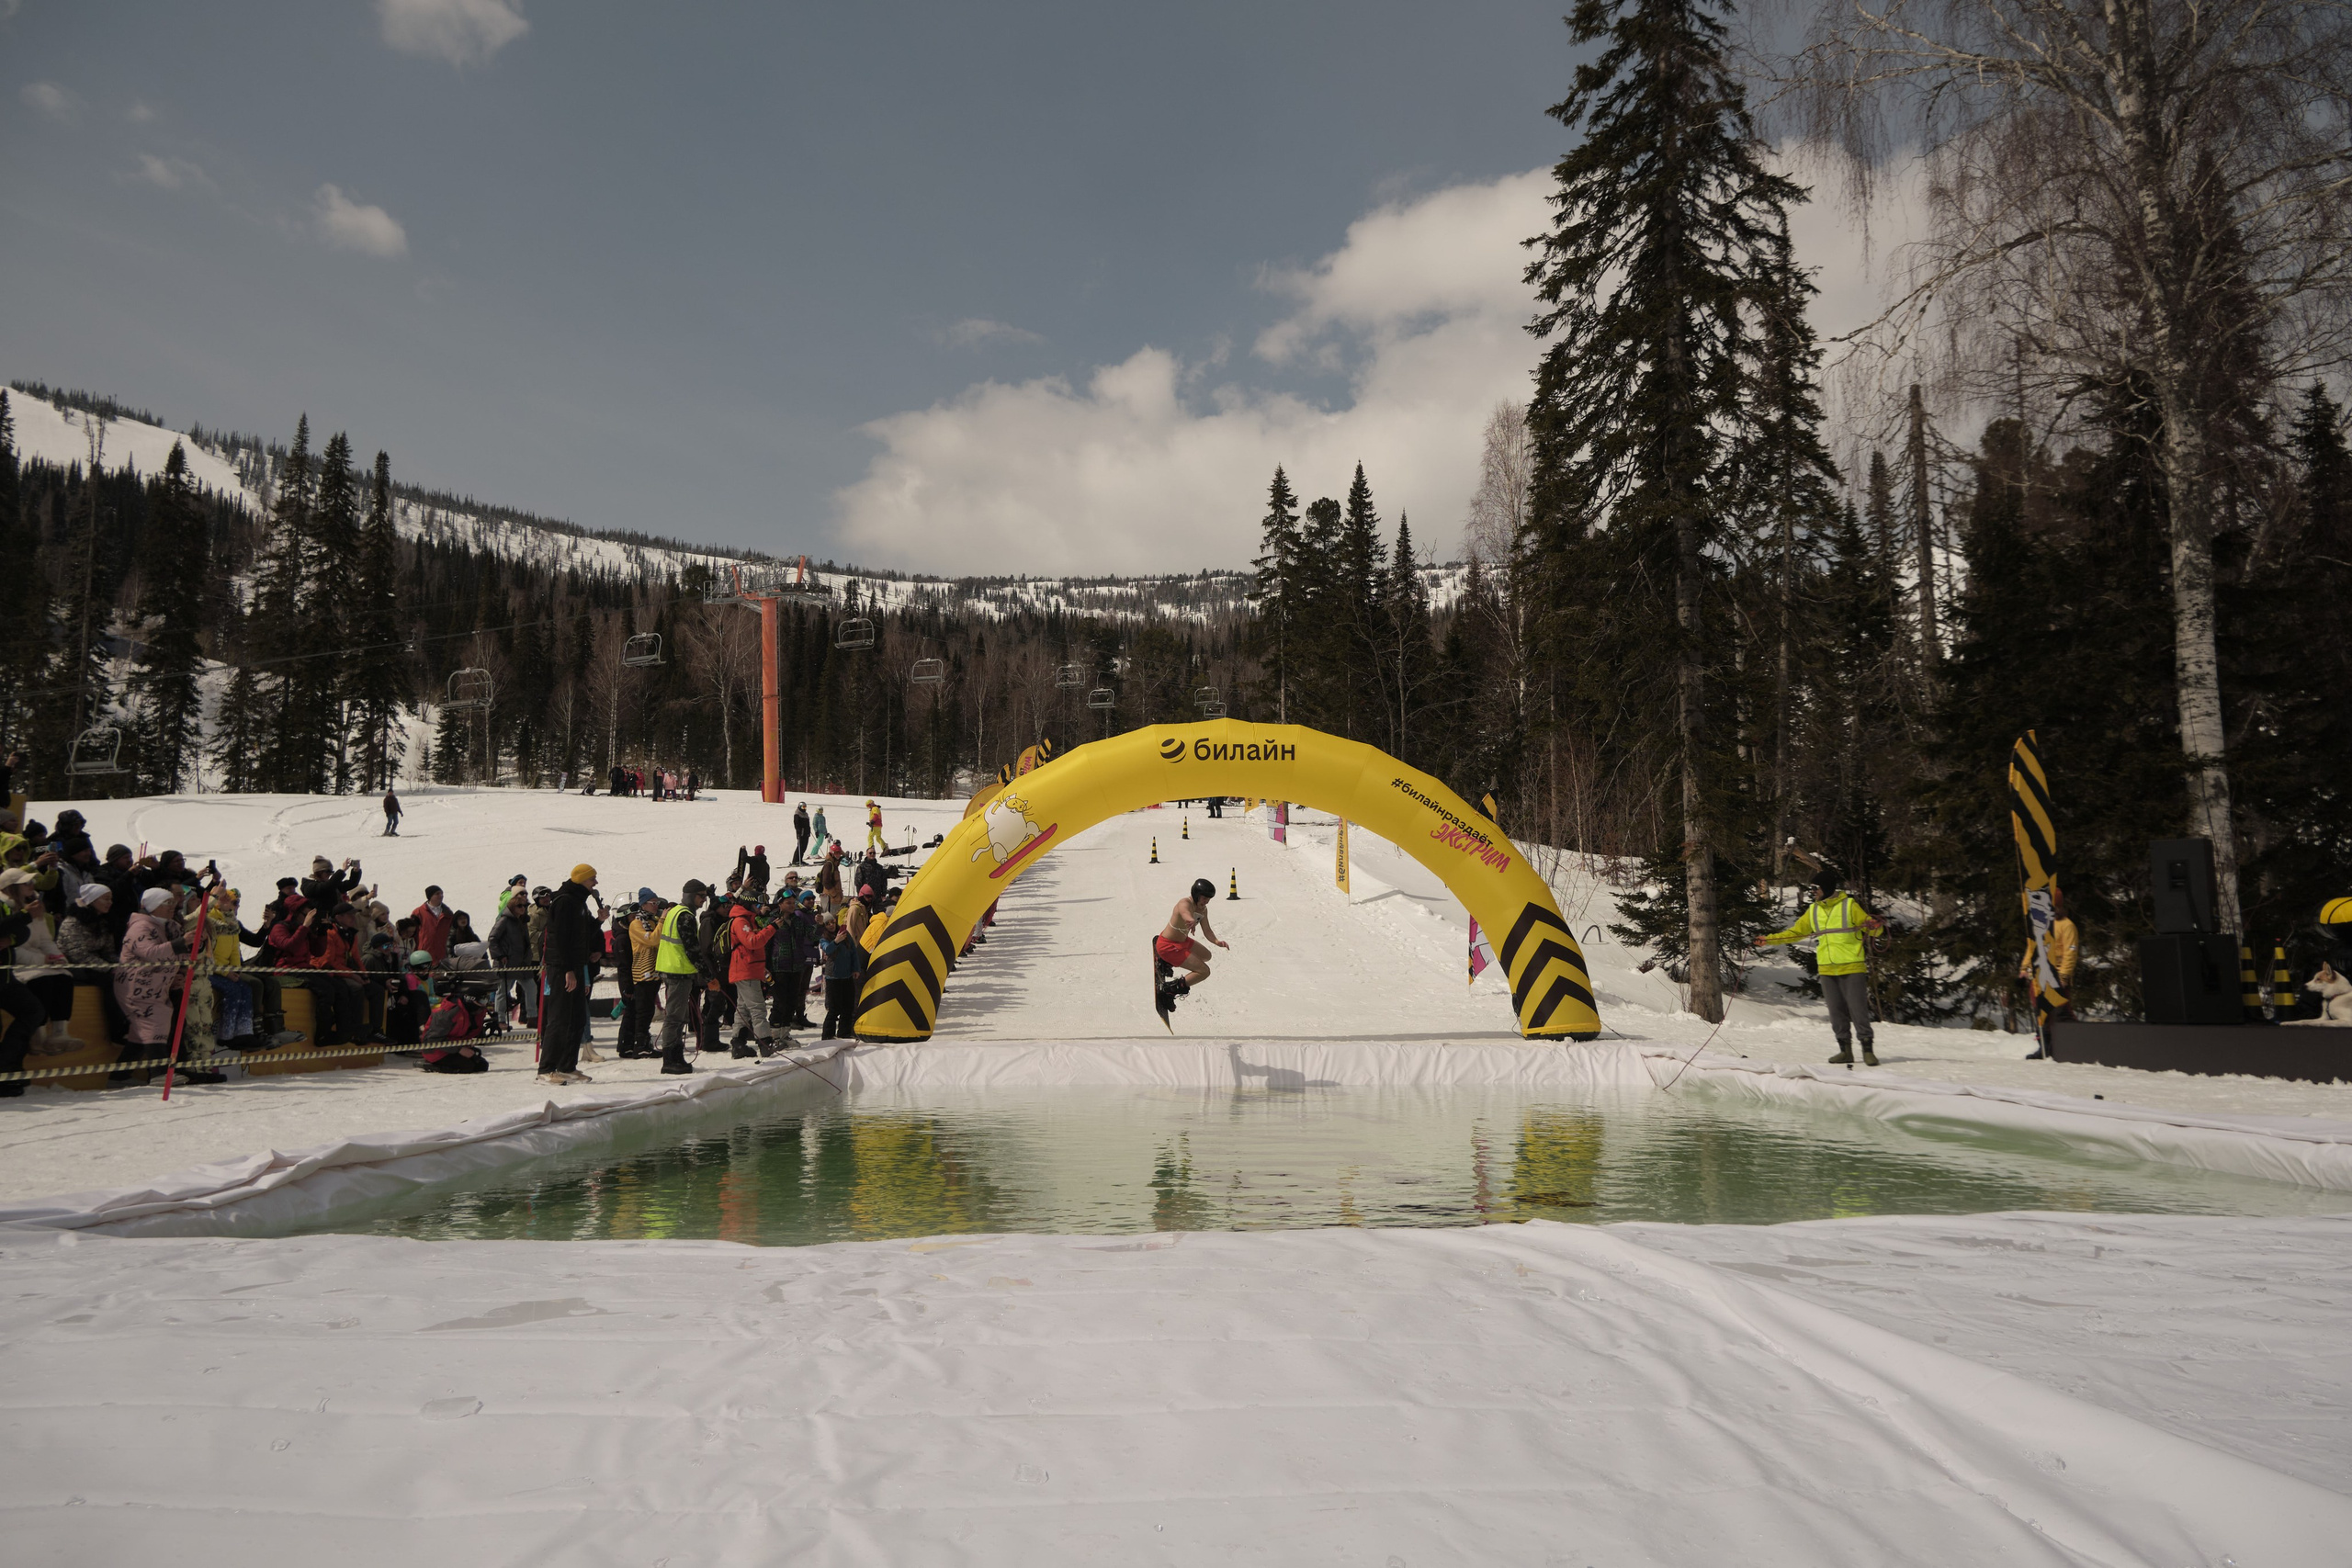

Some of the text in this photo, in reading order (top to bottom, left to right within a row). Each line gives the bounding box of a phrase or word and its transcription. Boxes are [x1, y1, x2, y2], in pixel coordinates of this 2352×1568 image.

[1194, 738, 1295, 761] билайн
[1390, 777, 1494, 848] #билайнраздаёт
[1430, 822, 1511, 874] ЭКСТРИМ
